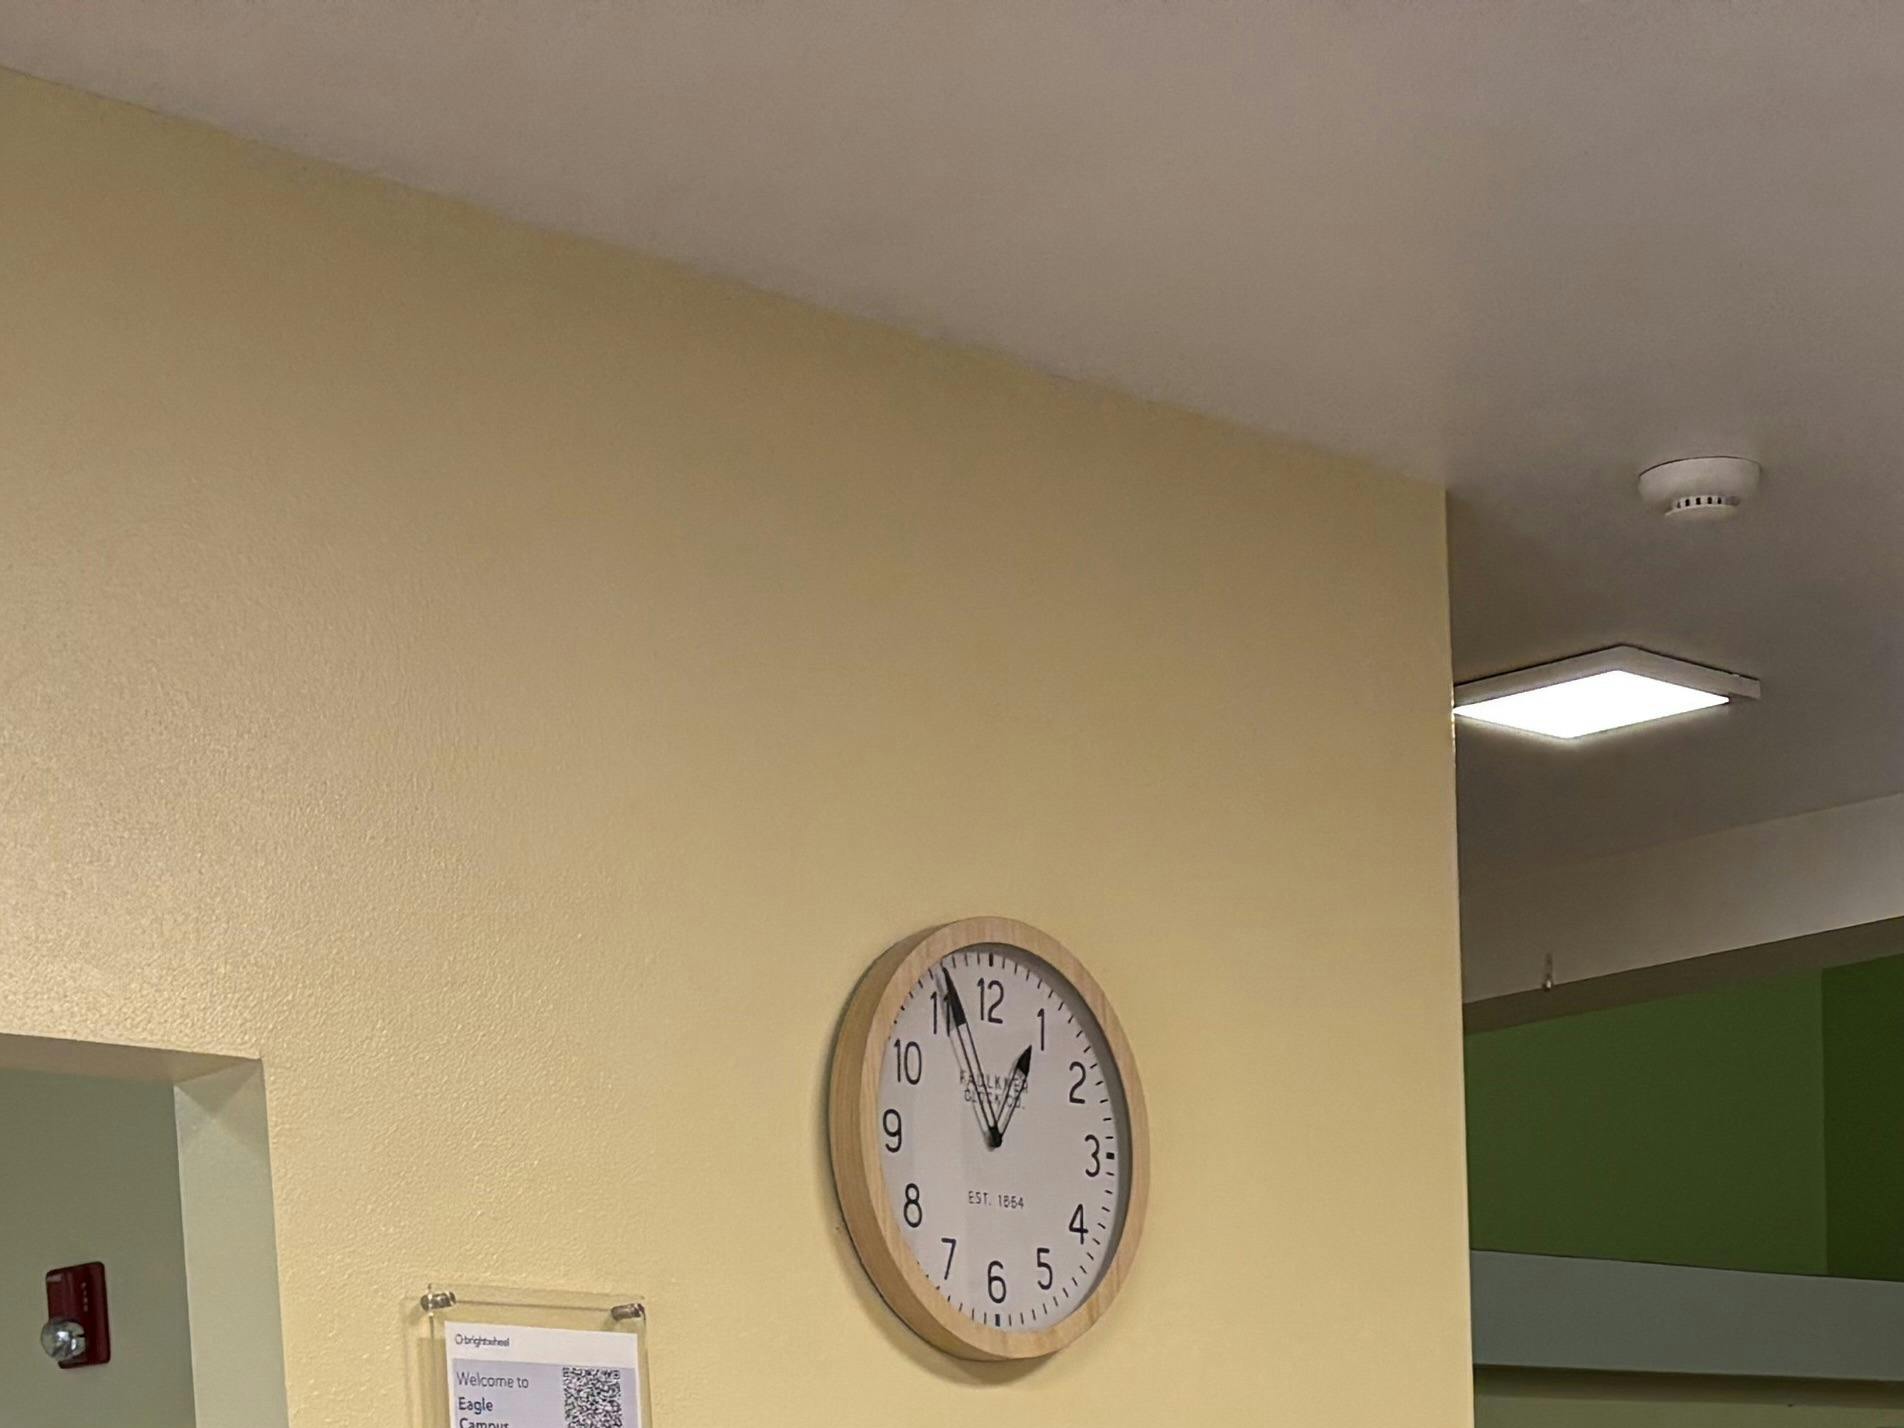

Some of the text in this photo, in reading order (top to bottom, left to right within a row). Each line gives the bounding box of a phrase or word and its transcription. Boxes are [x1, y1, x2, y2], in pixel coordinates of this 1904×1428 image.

[977, 977, 1005, 1024] 12
[1037, 1008, 1046, 1051] 1
[894, 1038, 923, 1085] 10
[1068, 1061, 1086, 1104] 2
[882, 1108, 903, 1153] 9
[1084, 1134, 1101, 1178] 3
[903, 1182, 923, 1228] 8
[968, 1190, 992, 1206] EST.
[1068, 1203, 1089, 1245] 4
[941, 1238, 958, 1281] 7
[1036, 1248, 1053, 1291] 5
[987, 1260, 1007, 1304] 6
[456, 1372, 529, 1389] Welcome to
[458, 1397, 493, 1414] Eagle
